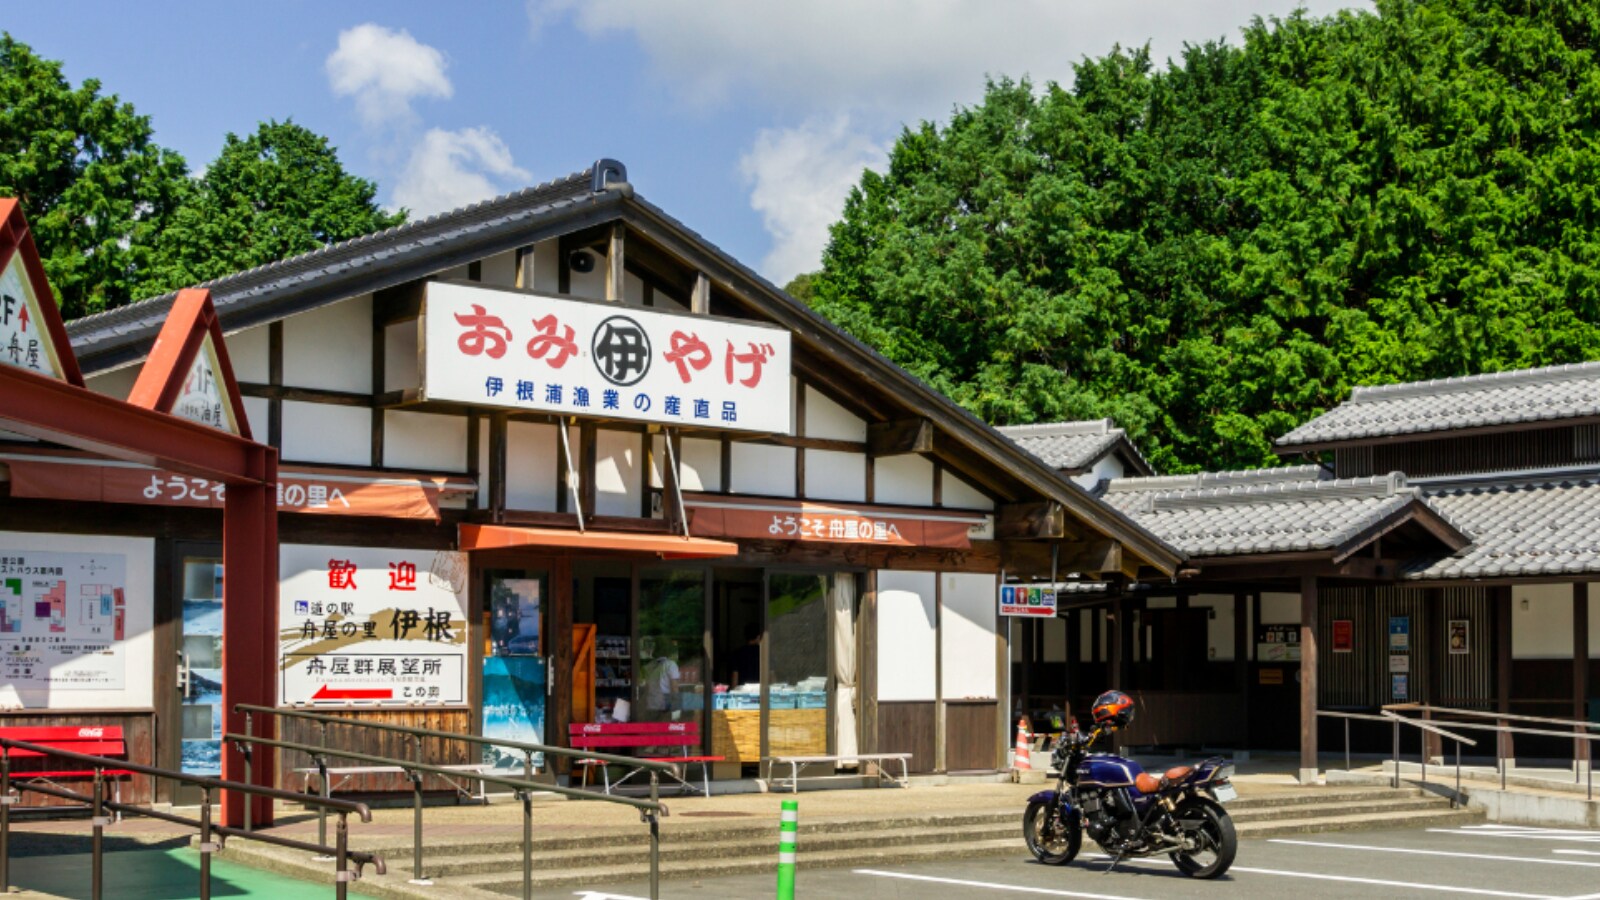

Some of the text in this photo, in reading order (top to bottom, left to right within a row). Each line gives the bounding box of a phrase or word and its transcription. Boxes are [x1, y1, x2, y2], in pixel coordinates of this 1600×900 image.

[485, 376, 738, 422] 伊根浦漁業の産直品
[768, 515, 902, 540] ようこそ 舟屋の里へ
[327, 558, 417, 591] 歓迎
[310, 601, 355, 616] 道の駅
[301, 607, 455, 642] 舟屋の里 伊根
[306, 656, 443, 676] 舟屋群展望所
[402, 686, 440, 699] この奥
